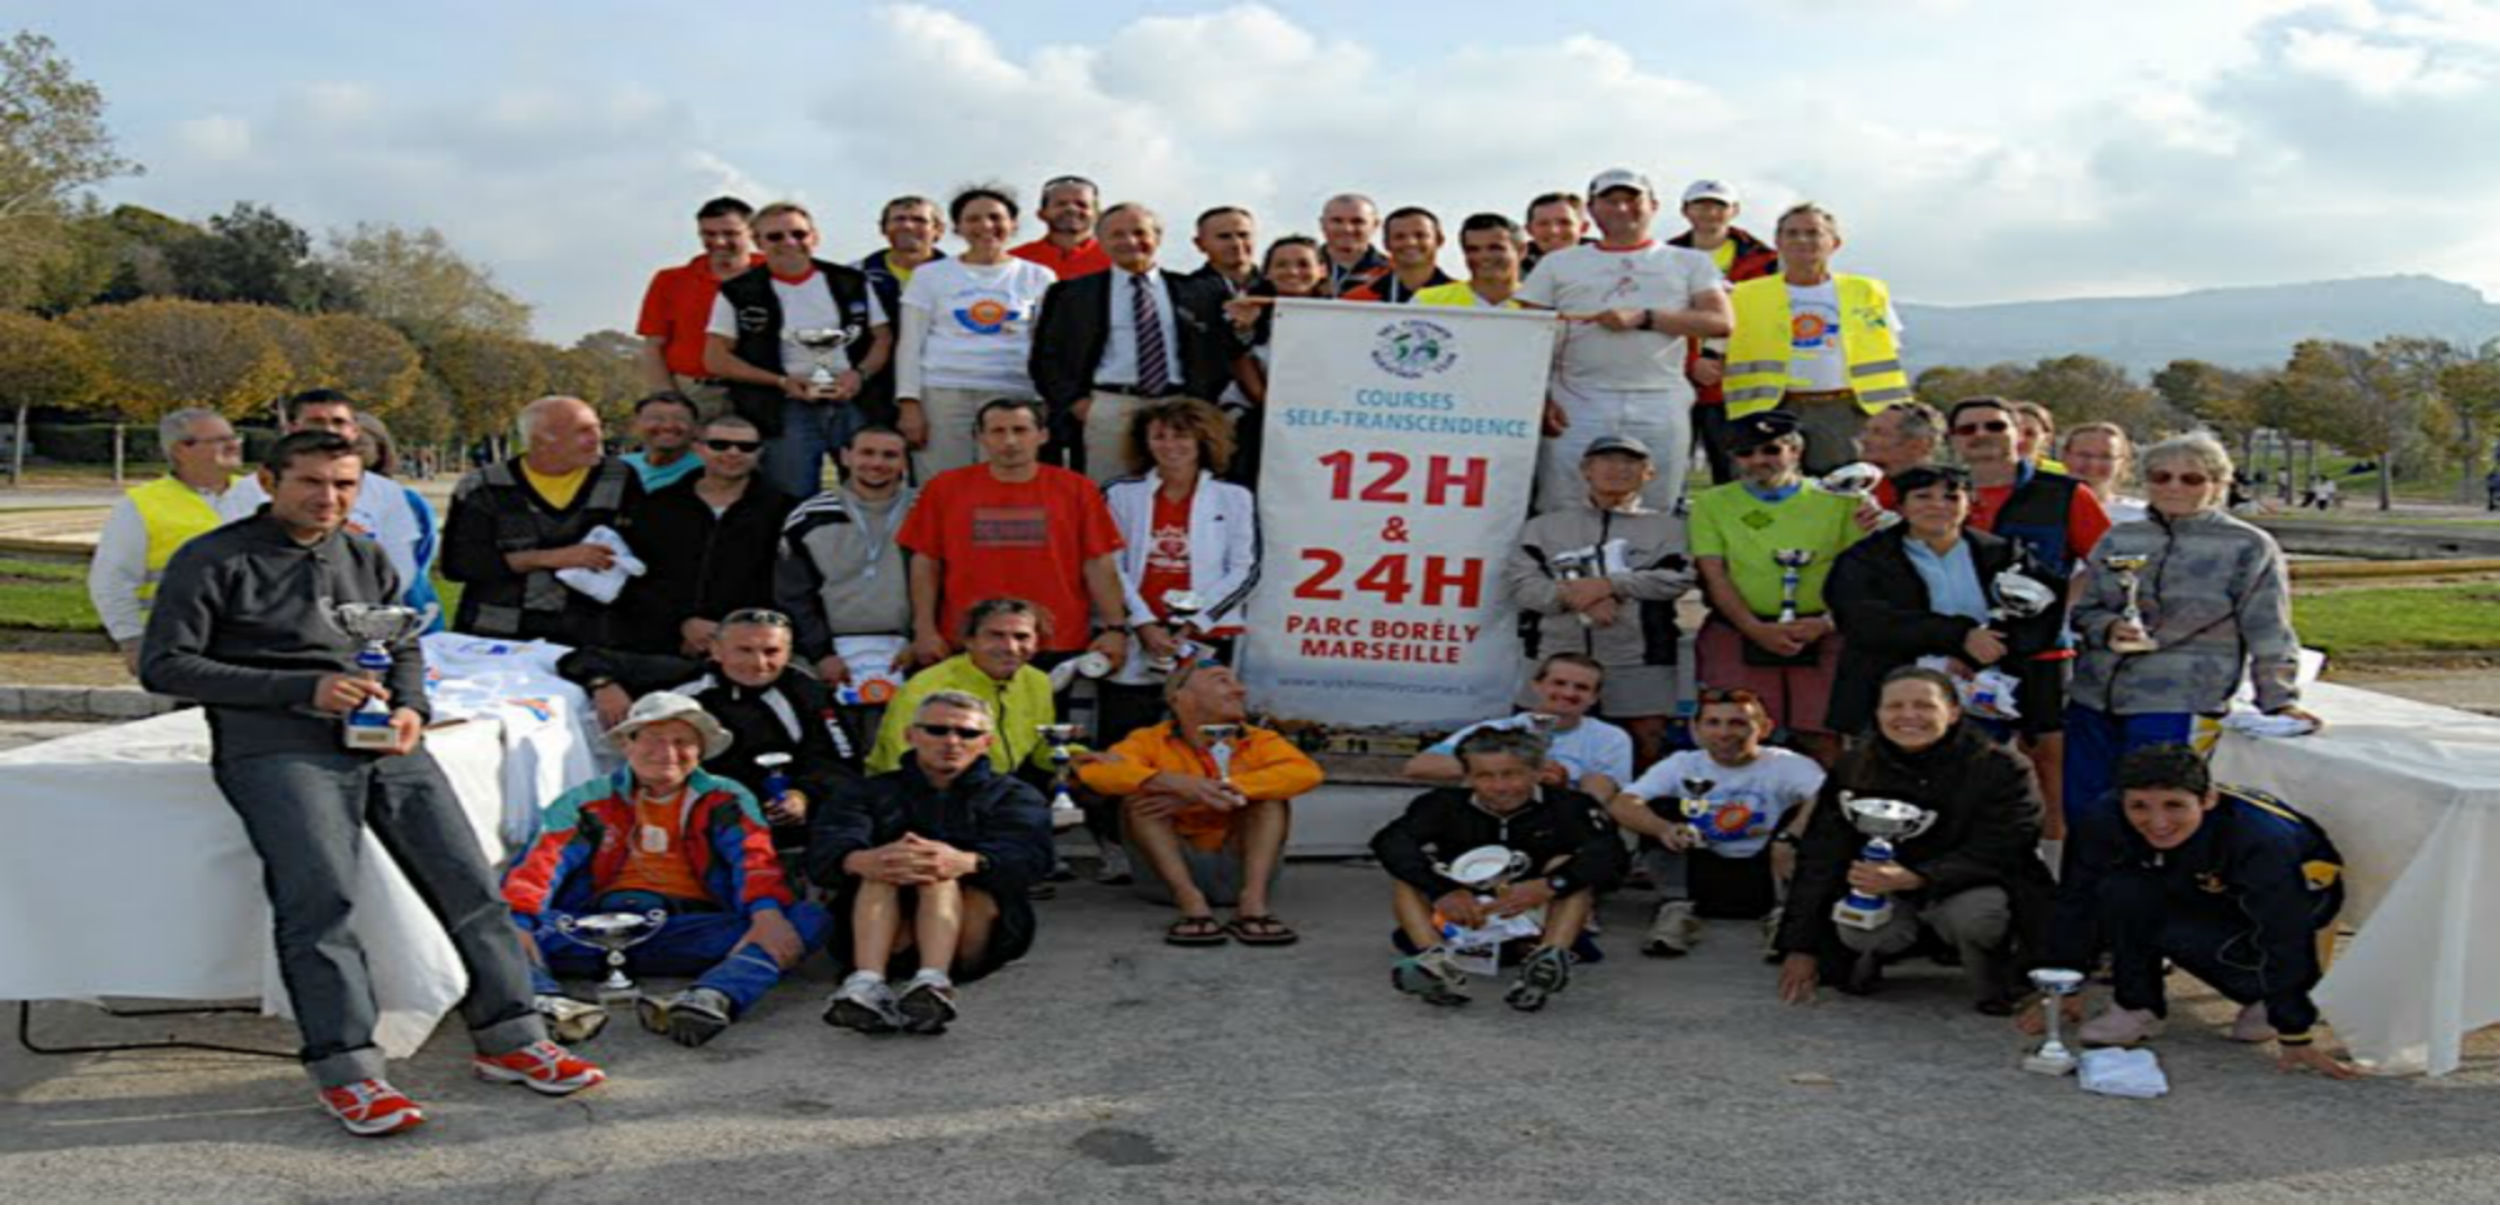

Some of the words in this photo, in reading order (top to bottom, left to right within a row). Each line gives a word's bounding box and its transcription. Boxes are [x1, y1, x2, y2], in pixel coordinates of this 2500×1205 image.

[1357, 389, 1455, 412] COURSES
[1284, 408, 1529, 438] SELF-TRANSCENDENCE
[1318, 450, 1489, 508] 12H
[1380, 516, 1409, 543] &
[1293, 547, 1485, 609] 24H
[1286, 615, 1360, 636] PARC
[1371, 618, 1480, 643] BORÉLY
[1301, 638, 1461, 664] MARSEILLE
